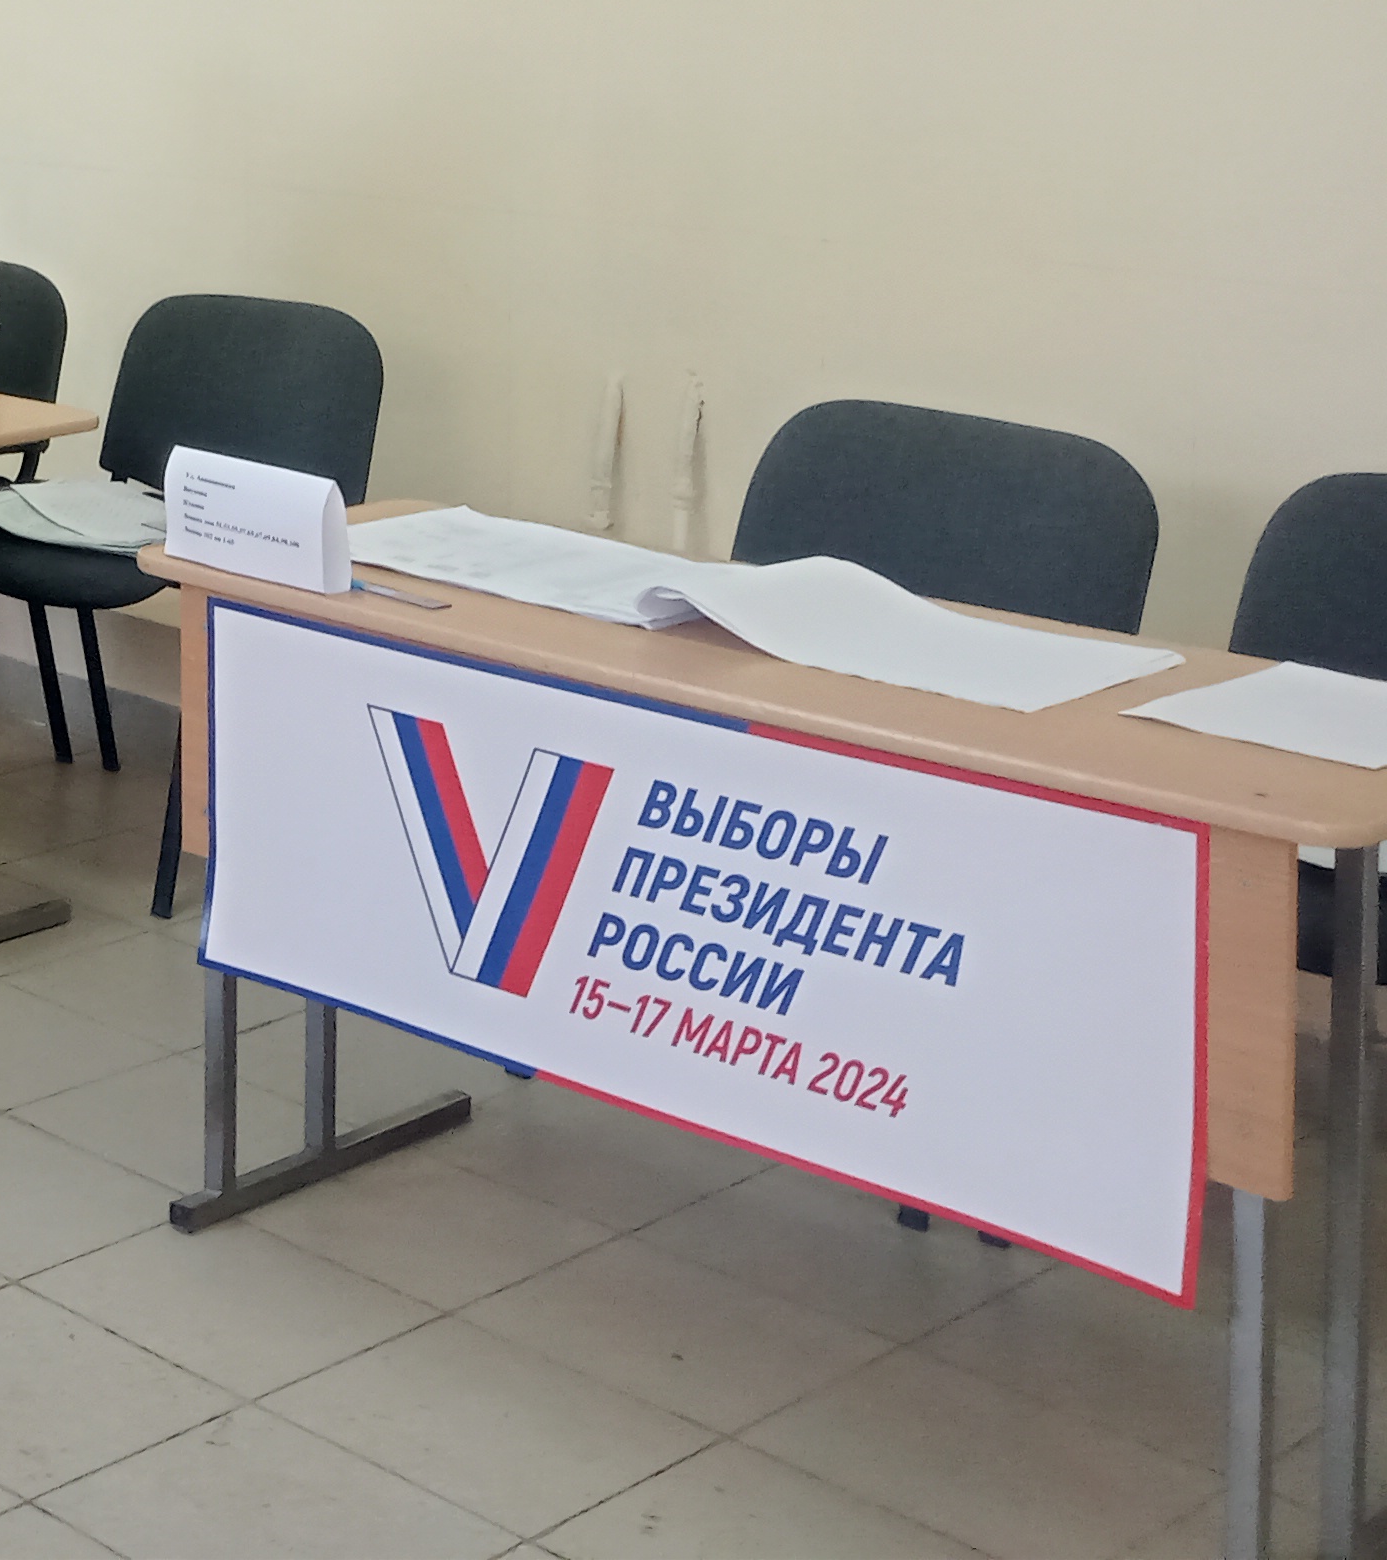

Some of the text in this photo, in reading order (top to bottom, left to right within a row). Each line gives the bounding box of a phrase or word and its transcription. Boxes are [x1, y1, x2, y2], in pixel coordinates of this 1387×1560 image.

[638, 779, 889, 885] ВЫБОРЫ
[587, 912, 804, 1016] РОССИИ
[612, 846, 966, 987] ПРЕЗИДЕНТА
[671, 1007, 802, 1085] МАРТА
[807, 1051, 910, 1118] 2024
